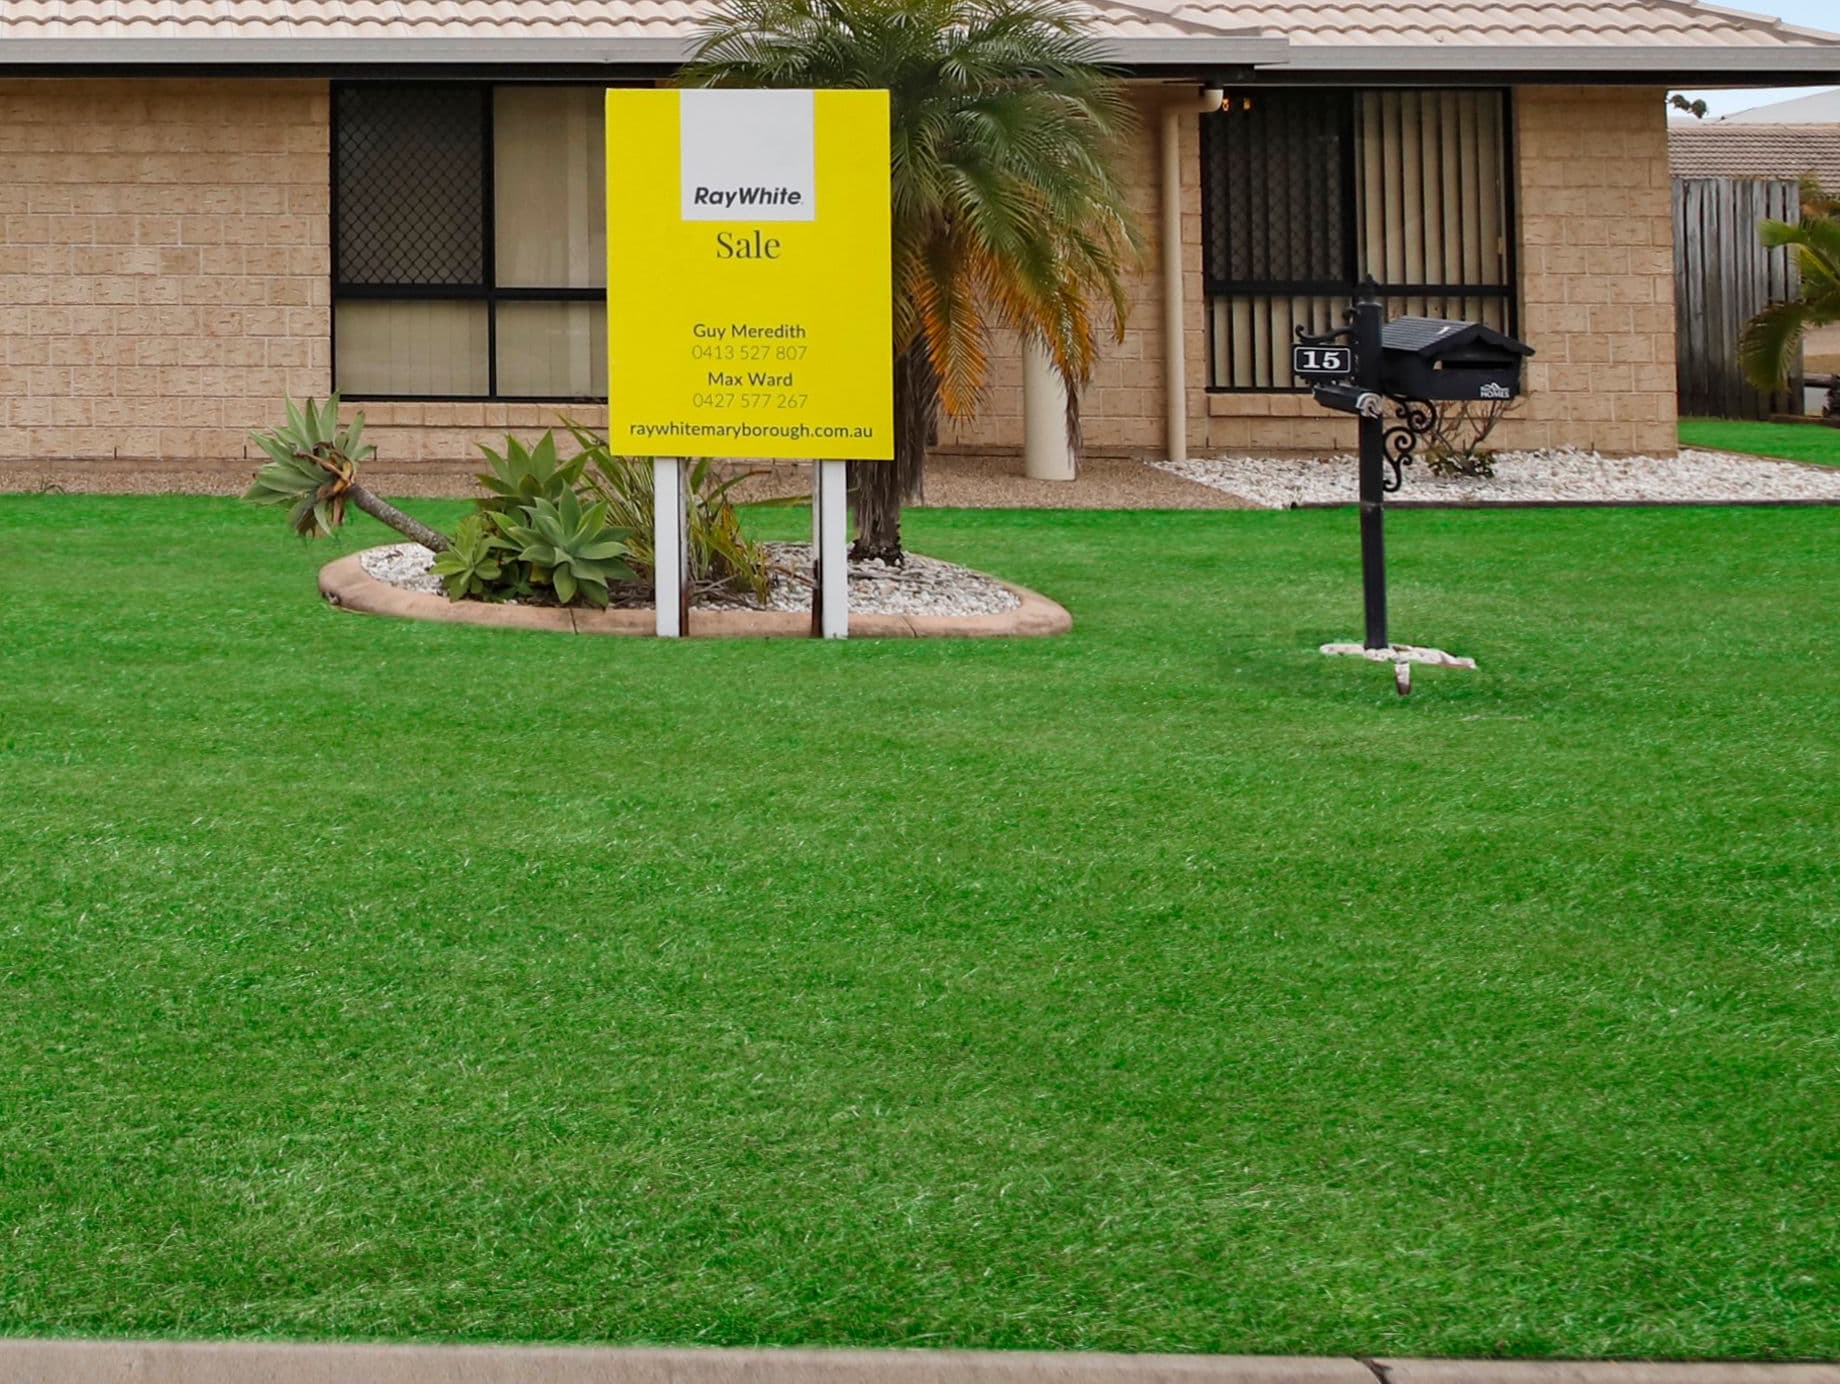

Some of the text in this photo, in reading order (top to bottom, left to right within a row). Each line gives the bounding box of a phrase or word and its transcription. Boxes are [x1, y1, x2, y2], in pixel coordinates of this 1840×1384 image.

[716, 229, 781, 260] Sale
[693, 323, 807, 340] Guy Meredith
[692, 345, 808, 361] 0413 527 807
[1302, 350, 1342, 370] 15
[708, 371, 793, 387] Max Ward
[692, 393, 808, 409] 0427 577 267
[630, 420, 873, 441] raywhitemaryborough.com.au
